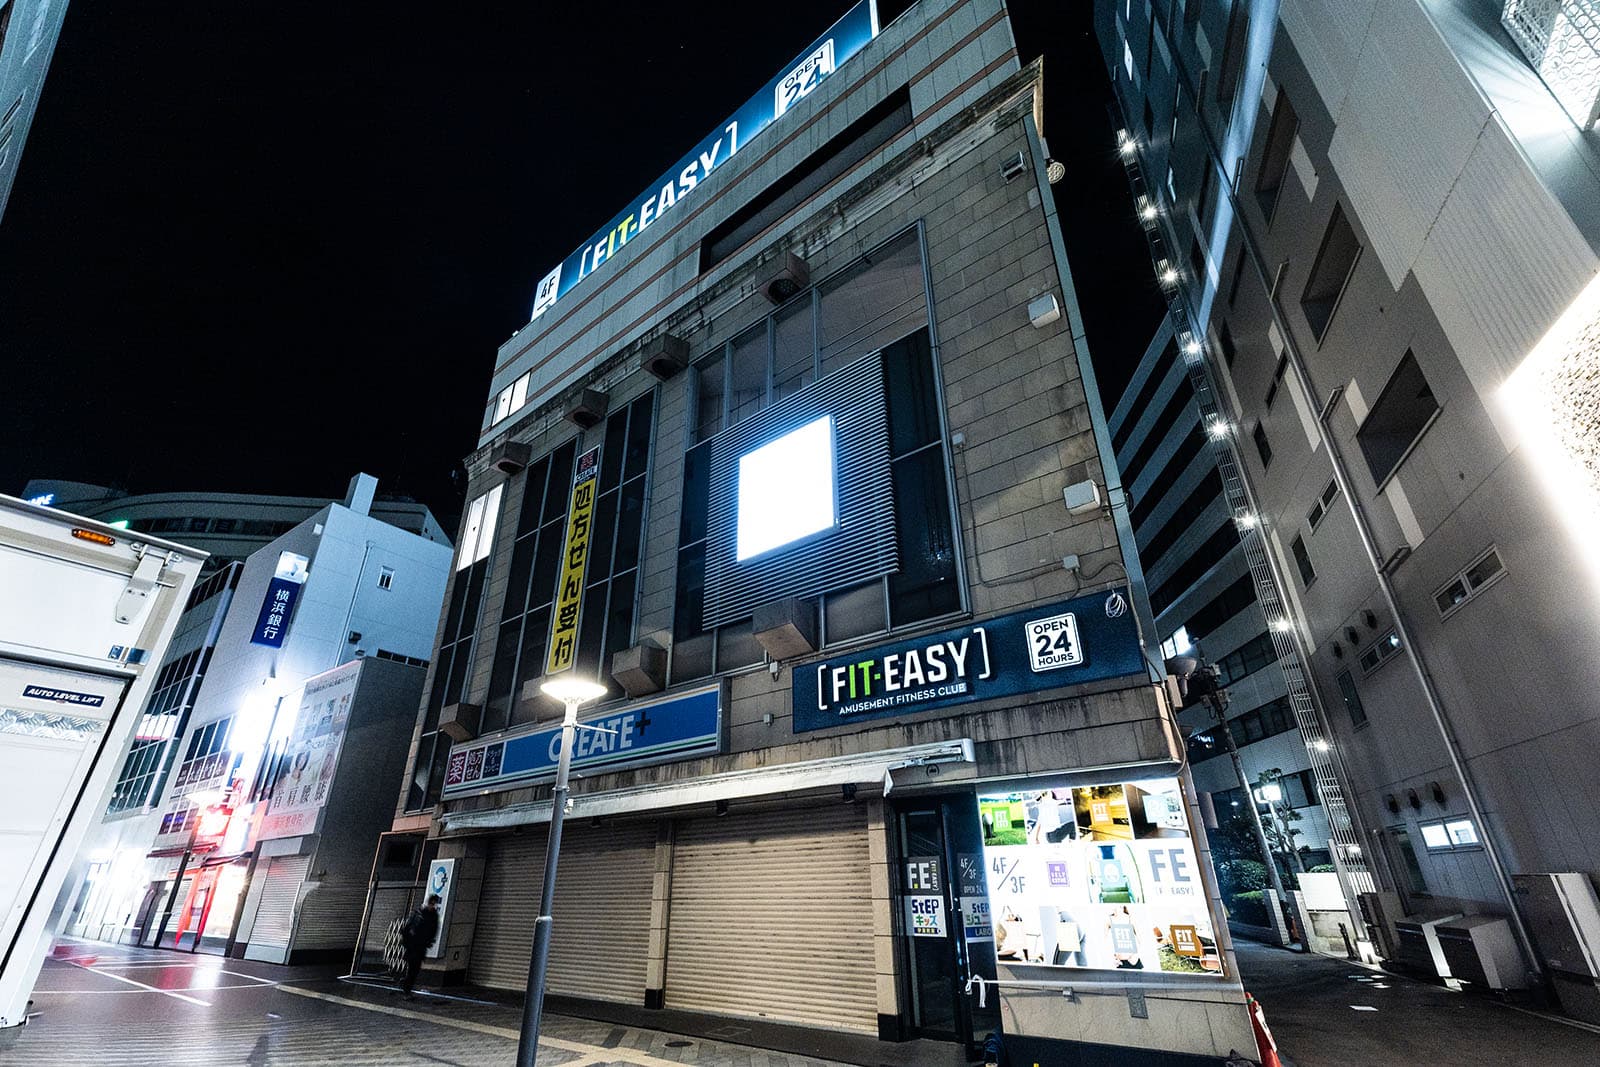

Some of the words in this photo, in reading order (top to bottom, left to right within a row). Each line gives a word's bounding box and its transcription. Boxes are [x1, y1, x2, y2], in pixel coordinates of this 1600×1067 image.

[784, 51, 823, 88] OPEN
[785, 64, 829, 109] 24
[540, 276, 555, 299] 4F
[554, 484, 591, 667] 処方せん受付
[263, 589, 290, 639] 横浜銀行
[1033, 619, 1069, 634] OPEN
[1035, 630, 1072, 657] 24
[1038, 652, 1074, 666] HOURS
[27, 688, 54, 697] AUTO
[54, 691, 81, 702] LEVEL
[839, 697, 898, 715] AMUSEMENT
[896, 689, 936, 704] FITNESS
[937, 681, 968, 696] CLUB
[448, 755, 465, 782] 薬
[1114, 928, 1131, 940] FIT
[1175, 929, 1193, 942] FIT
